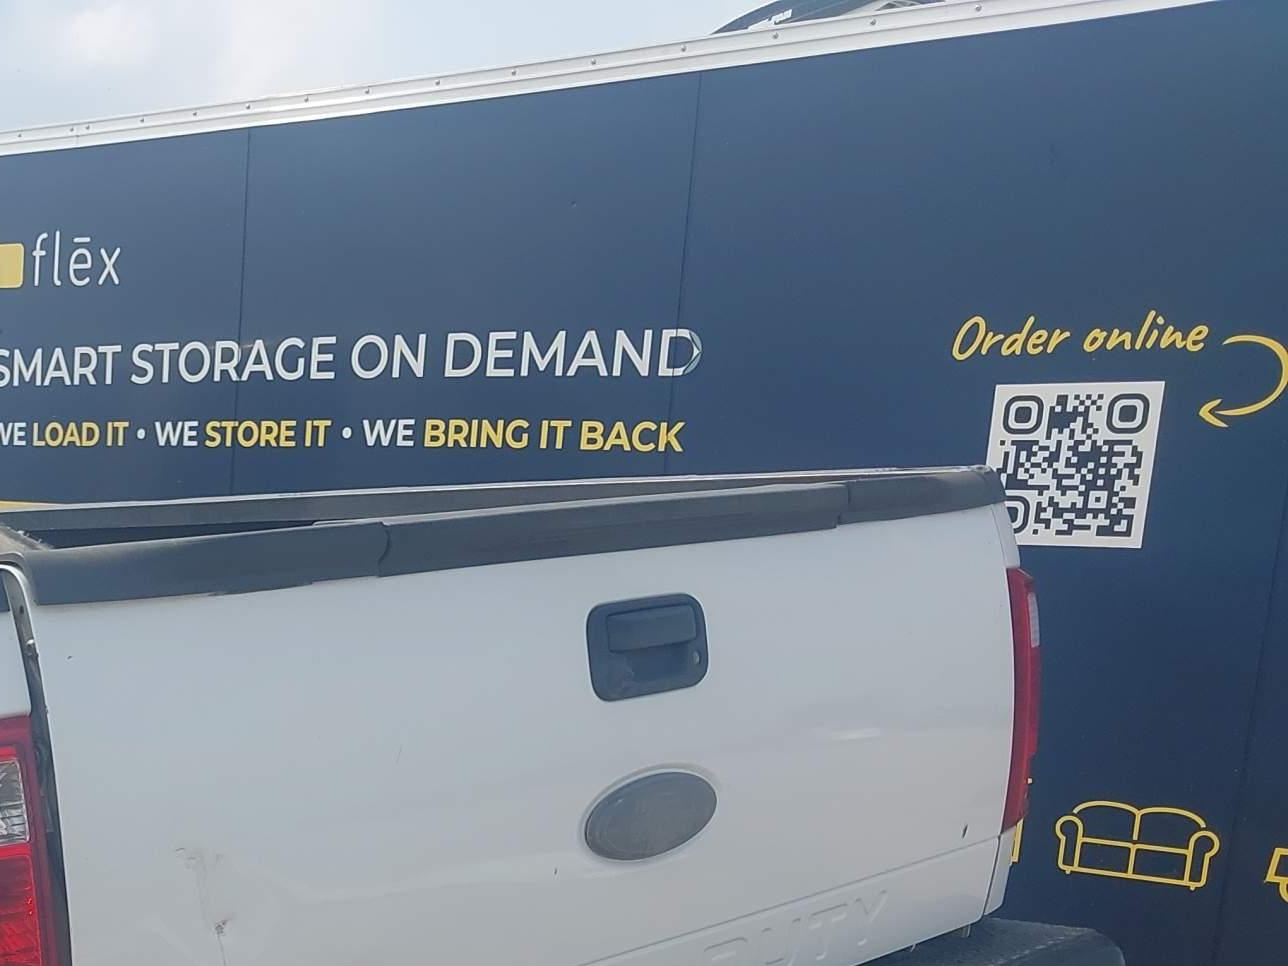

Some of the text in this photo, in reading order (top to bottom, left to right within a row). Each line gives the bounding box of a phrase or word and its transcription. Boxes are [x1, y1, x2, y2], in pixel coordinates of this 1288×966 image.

[129, 336, 337, 384] STORAGE
[350, 332, 428, 379] ON
[443, 328, 704, 378] DEMAND
[951, 308, 1210, 362] Order online
[31, 421, 101, 448] LOAD
[105, 420, 130, 447] IT
[154, 420, 200, 447] WE
[203, 419, 298, 448] STORE
[303, 419, 333, 448] IT
[361, 418, 416, 448] WE
[422, 418, 531, 450] BRING
[538, 419, 573, 450] IT
[578, 420, 687, 452] BACK
